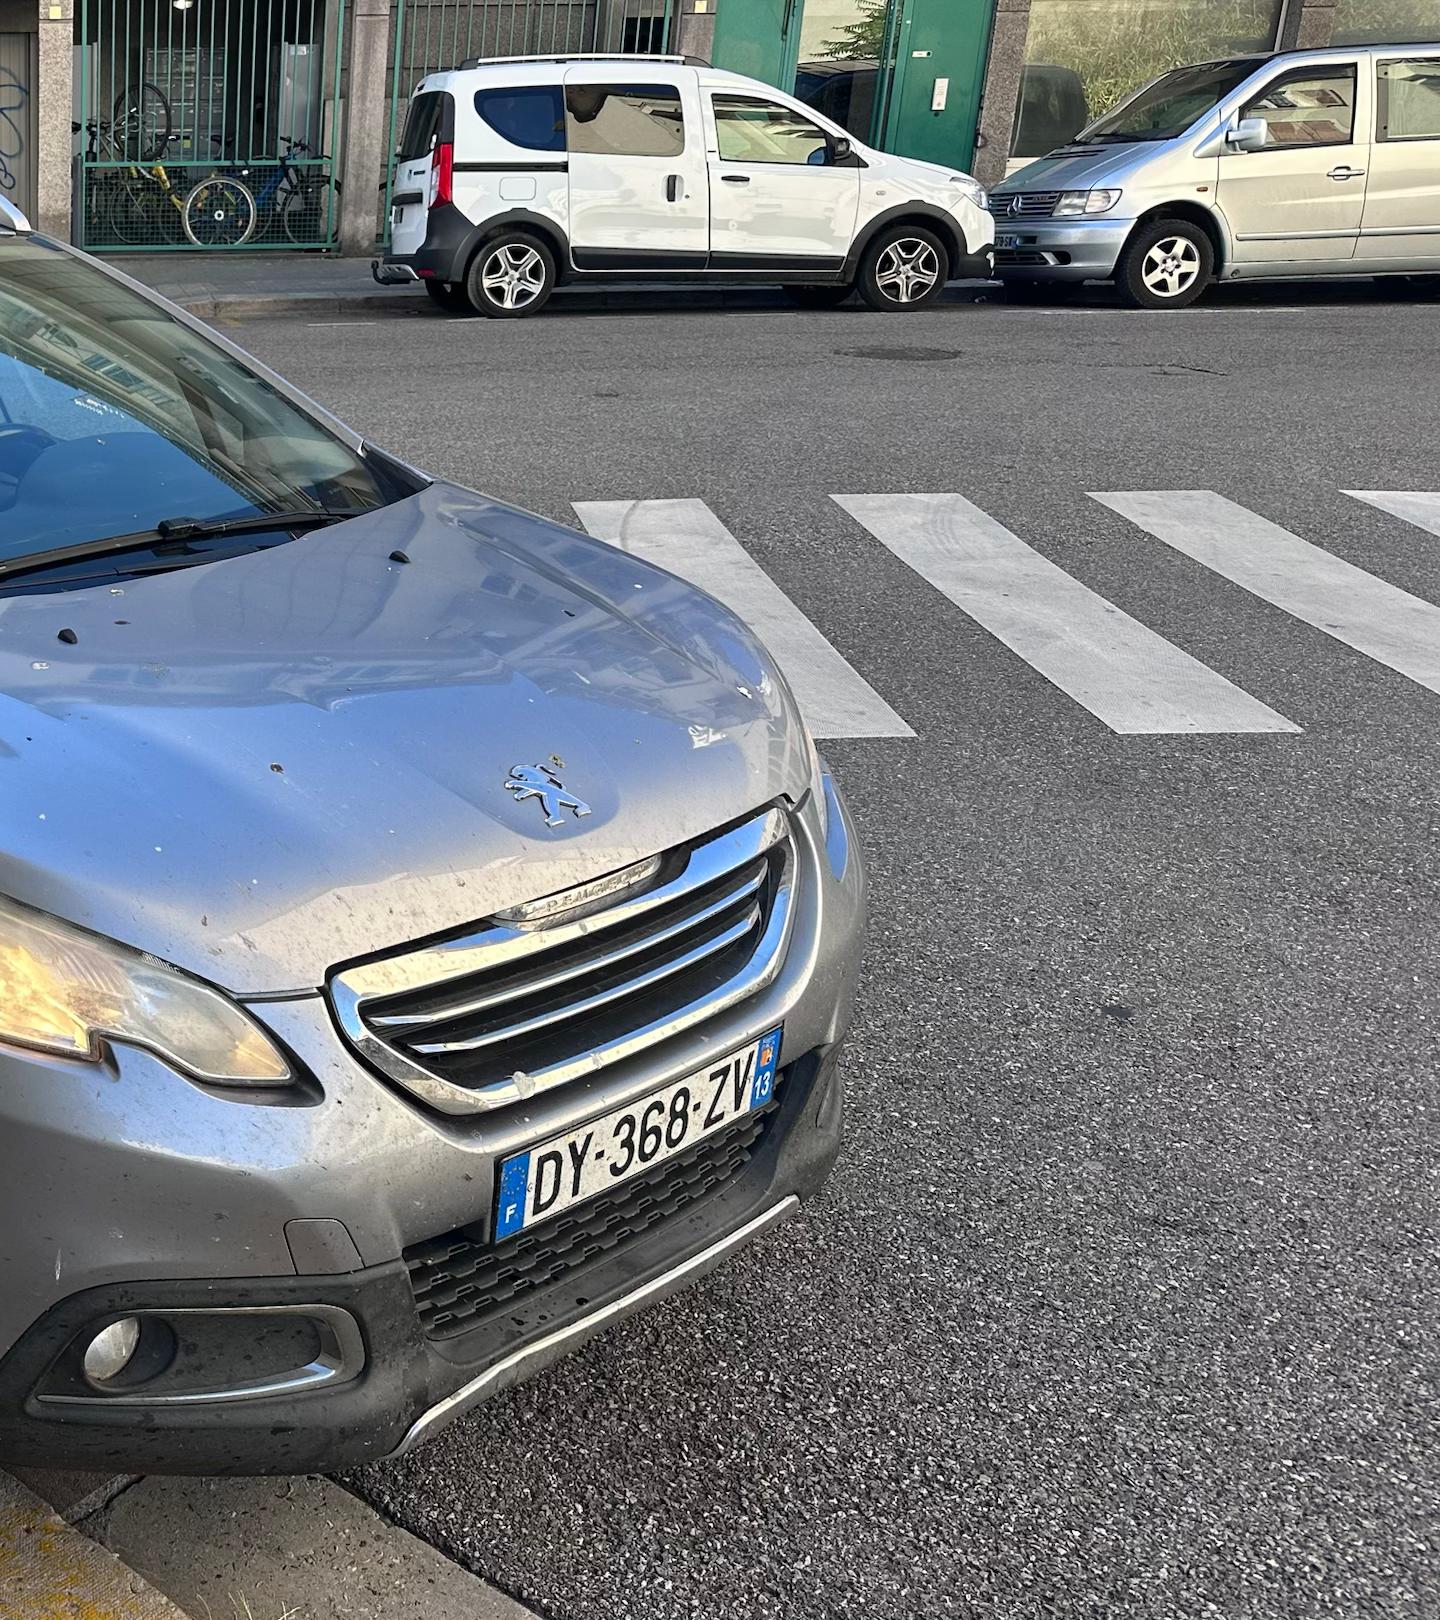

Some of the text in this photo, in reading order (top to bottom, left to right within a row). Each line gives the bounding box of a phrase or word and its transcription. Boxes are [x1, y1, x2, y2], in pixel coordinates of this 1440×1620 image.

[754, 1070, 770, 1099] 13
[532, 1050, 755, 1217] DY-368-ZV
[505, 1203, 517, 1223] F
